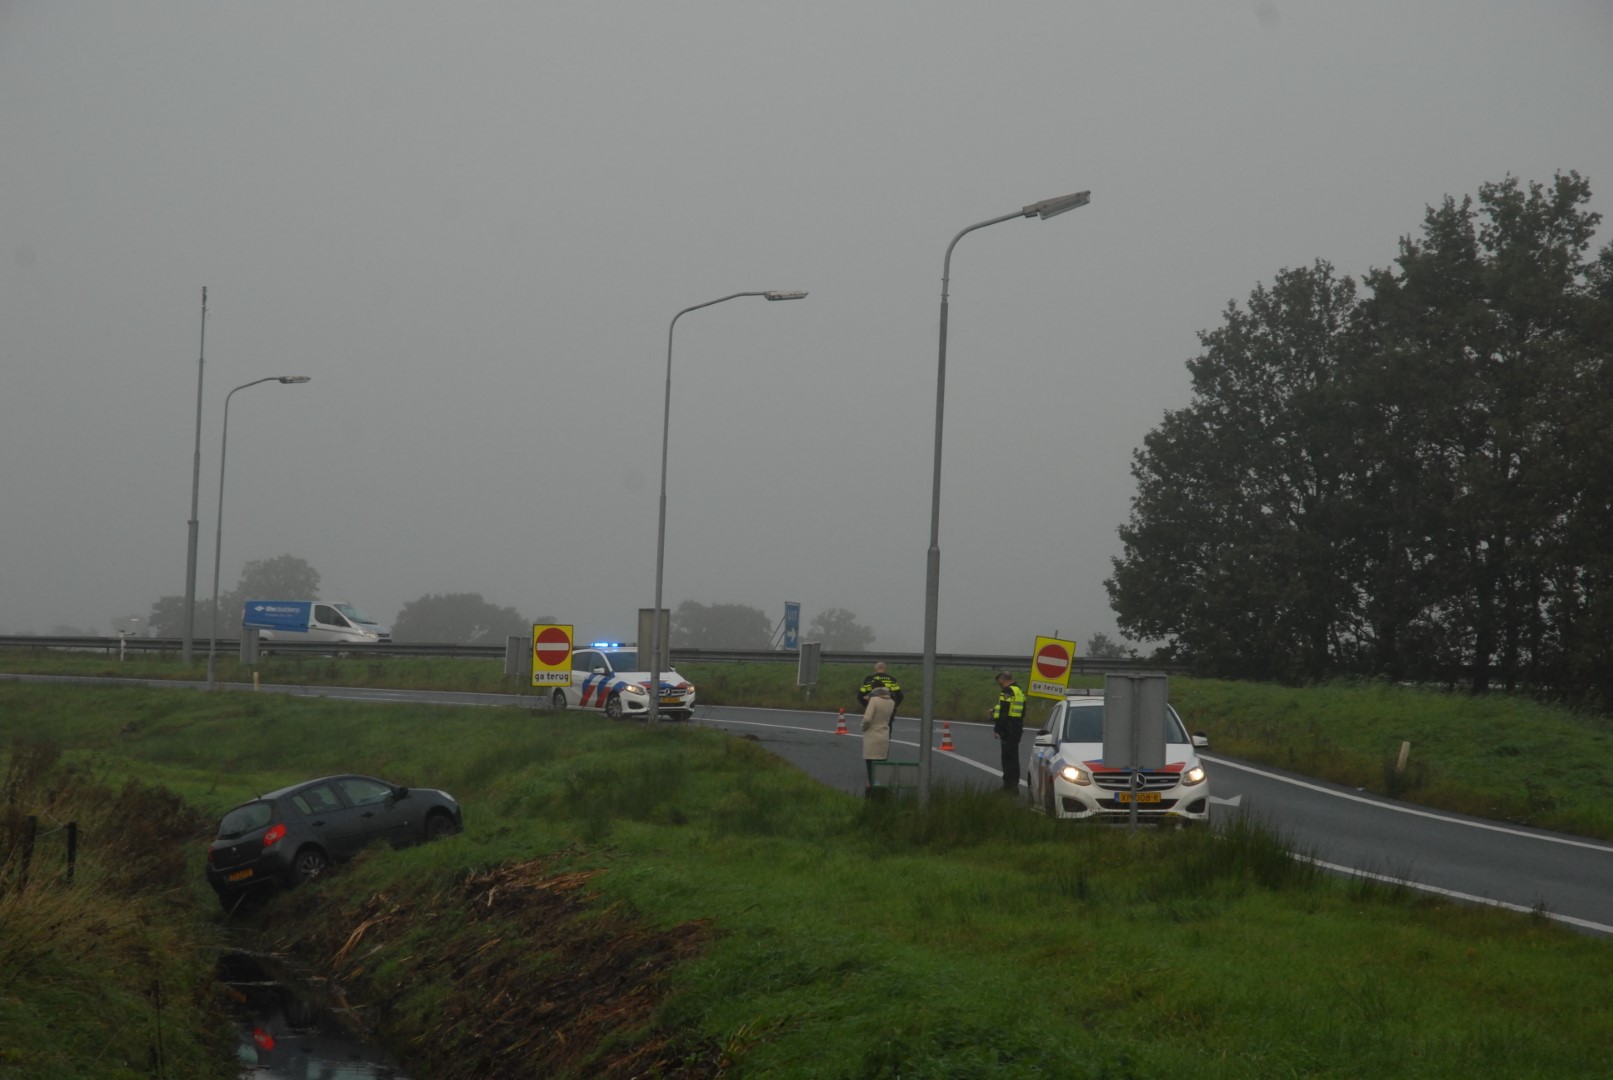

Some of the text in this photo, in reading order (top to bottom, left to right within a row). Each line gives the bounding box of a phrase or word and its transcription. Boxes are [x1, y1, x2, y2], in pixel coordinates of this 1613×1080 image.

[535, 672, 569, 682] ga terug
[1043, 684, 1063, 694] terug
